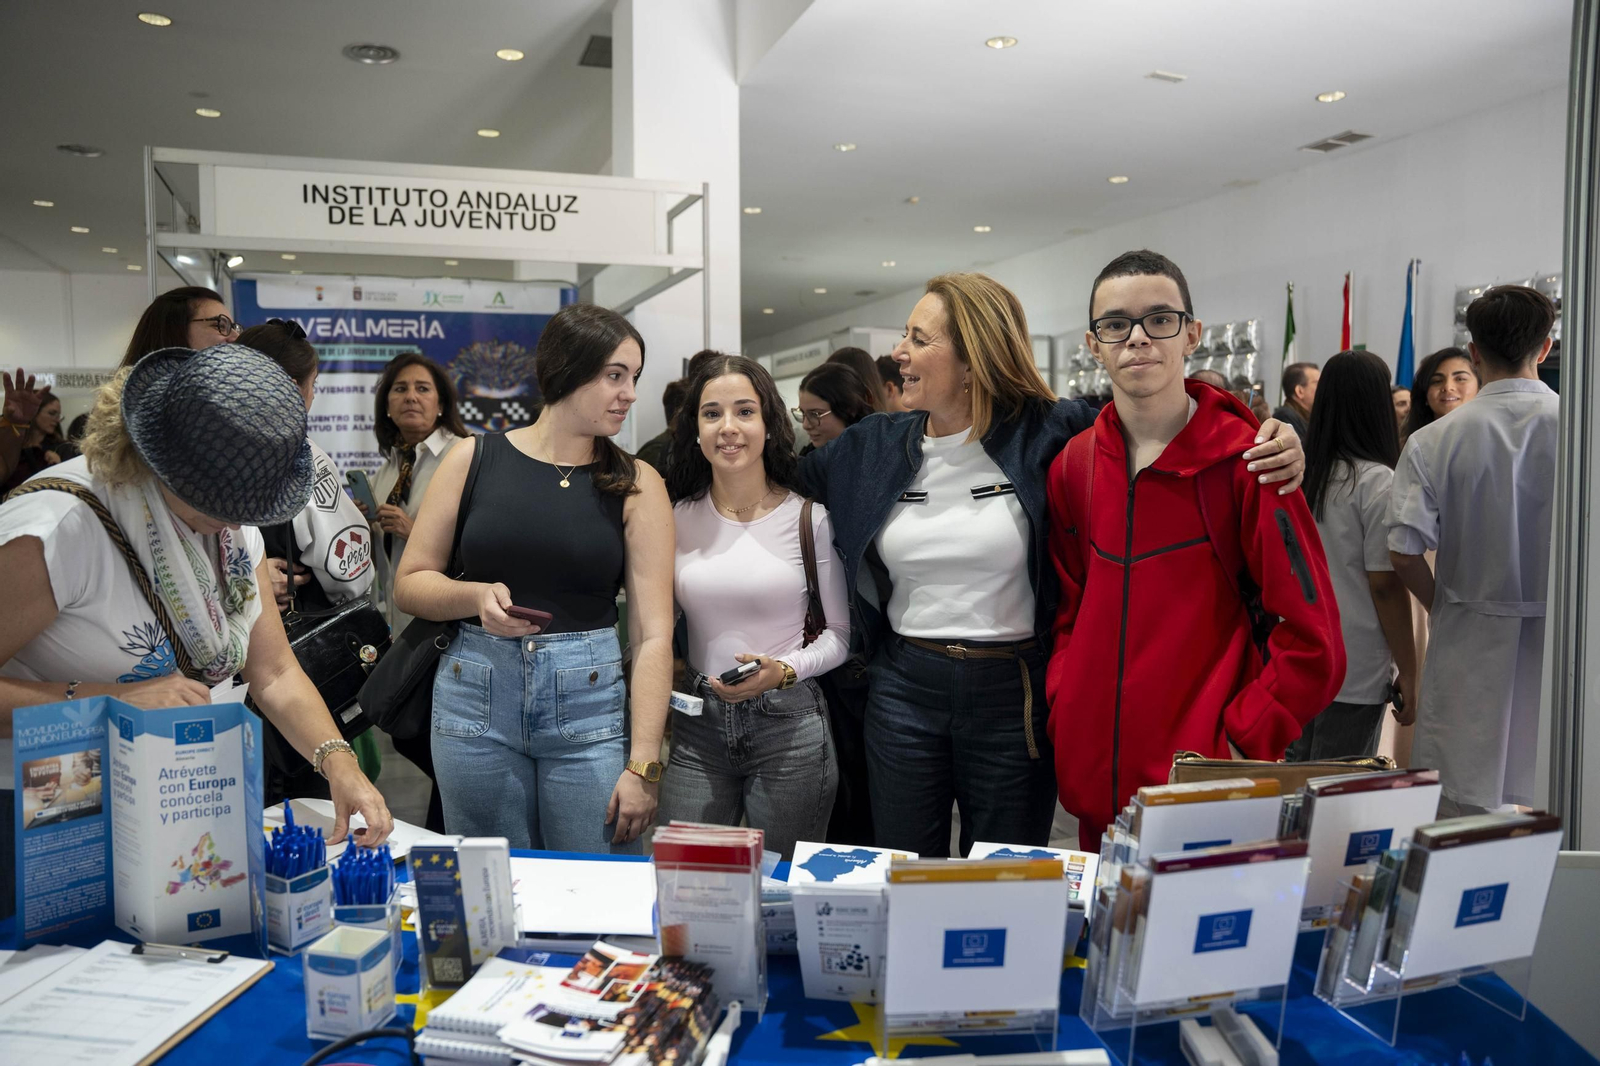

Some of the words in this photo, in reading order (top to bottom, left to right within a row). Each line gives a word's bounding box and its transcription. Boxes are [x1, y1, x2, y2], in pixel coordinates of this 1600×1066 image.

[303, 184, 448, 208] INSTITUTO
[456, 190, 579, 214] ANDALUZ
[328, 205, 364, 226] DE
[373, 207, 406, 227] LA
[414, 208, 556, 231] JUVENTUD
[266, 315, 445, 339] VEALMERÍA
[313, 386, 365, 394] OVIEMBRE
[305, 424, 332, 432] NTUD
[339, 541, 369, 576] SPEED
[18, 722, 69, 738] MOVILIDAD
[62, 726, 105, 741] EUROPEA
[158, 764, 217, 781] Atrévete
[159, 782, 185, 795] con
[189, 777, 236, 792] Europa
[160, 790, 223, 809] conócela
[160, 813, 169, 825] y
[172, 804, 231, 824] participa
